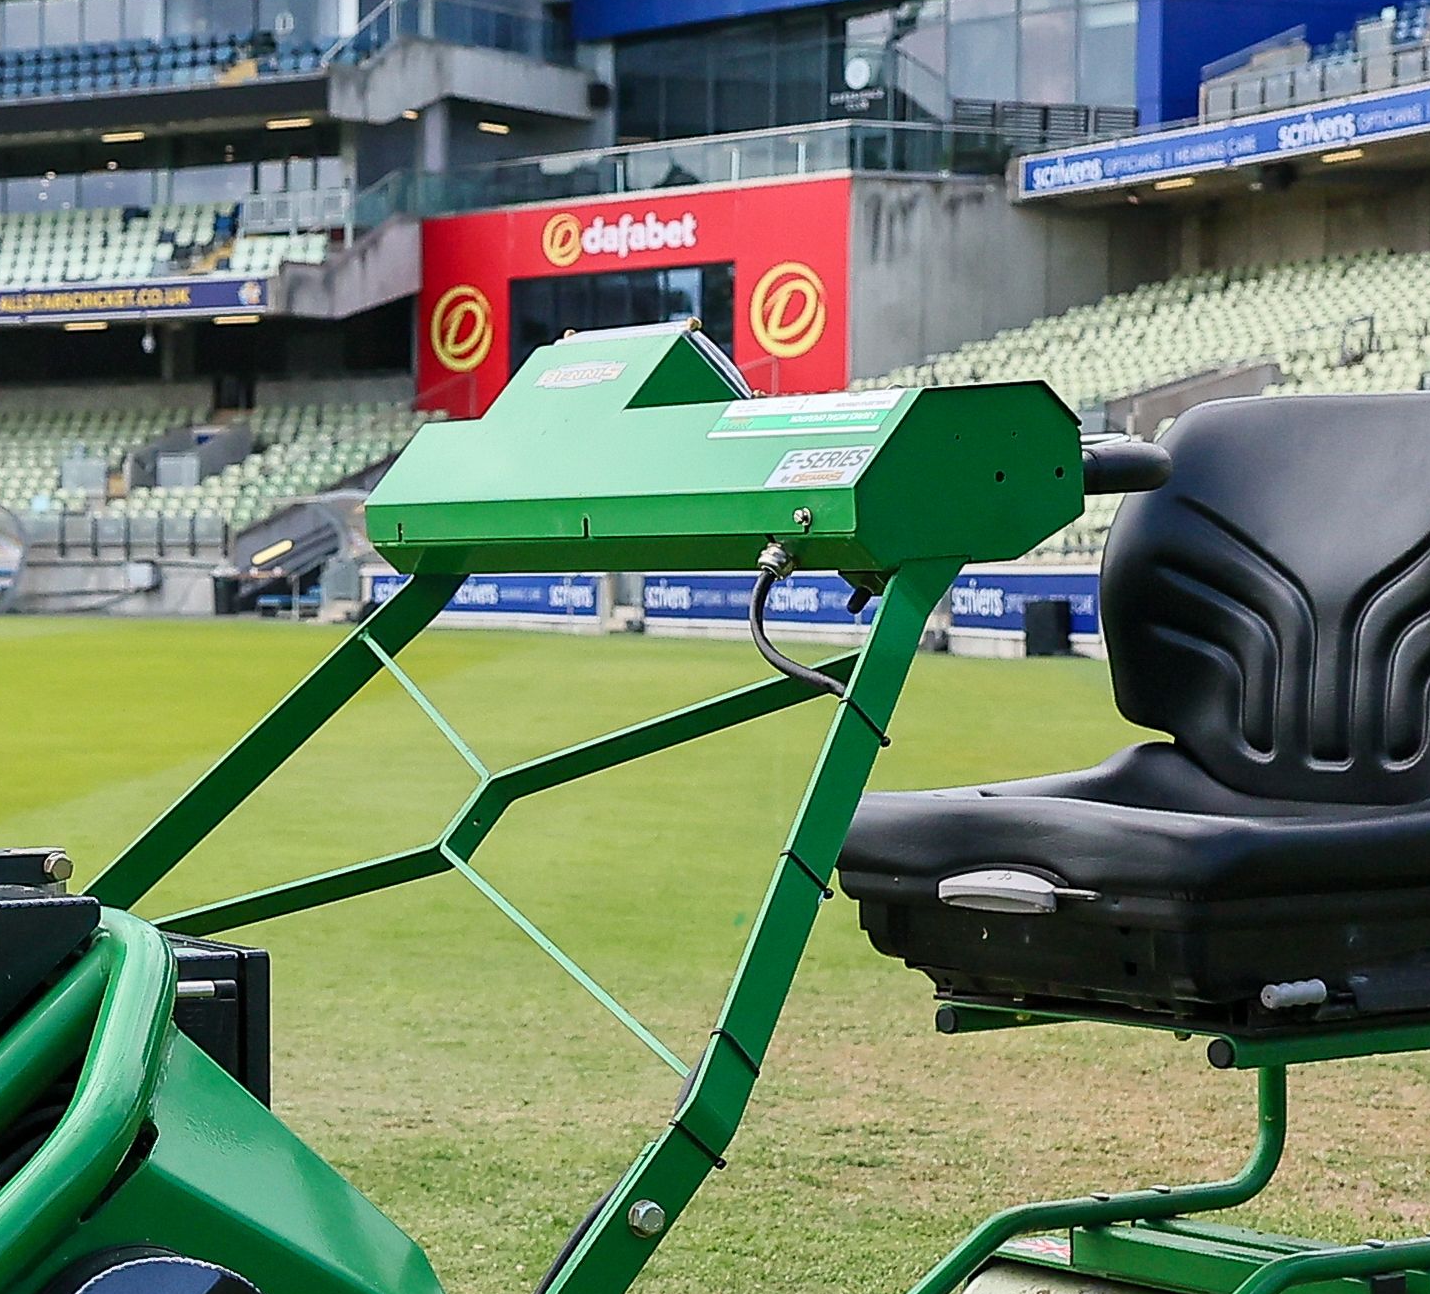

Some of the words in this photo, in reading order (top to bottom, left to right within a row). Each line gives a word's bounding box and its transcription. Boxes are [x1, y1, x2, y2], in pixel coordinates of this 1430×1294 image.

[1278, 113, 1356, 150] scrivens
[1032, 157, 1103, 189] scrivens
[581, 211, 699, 258] dafabet
[780, 449, 870, 470] E-SERIES
[644, 579, 691, 610] scrivens
[769, 579, 819, 612] scrivens
[951, 579, 1004, 617] scrivens
